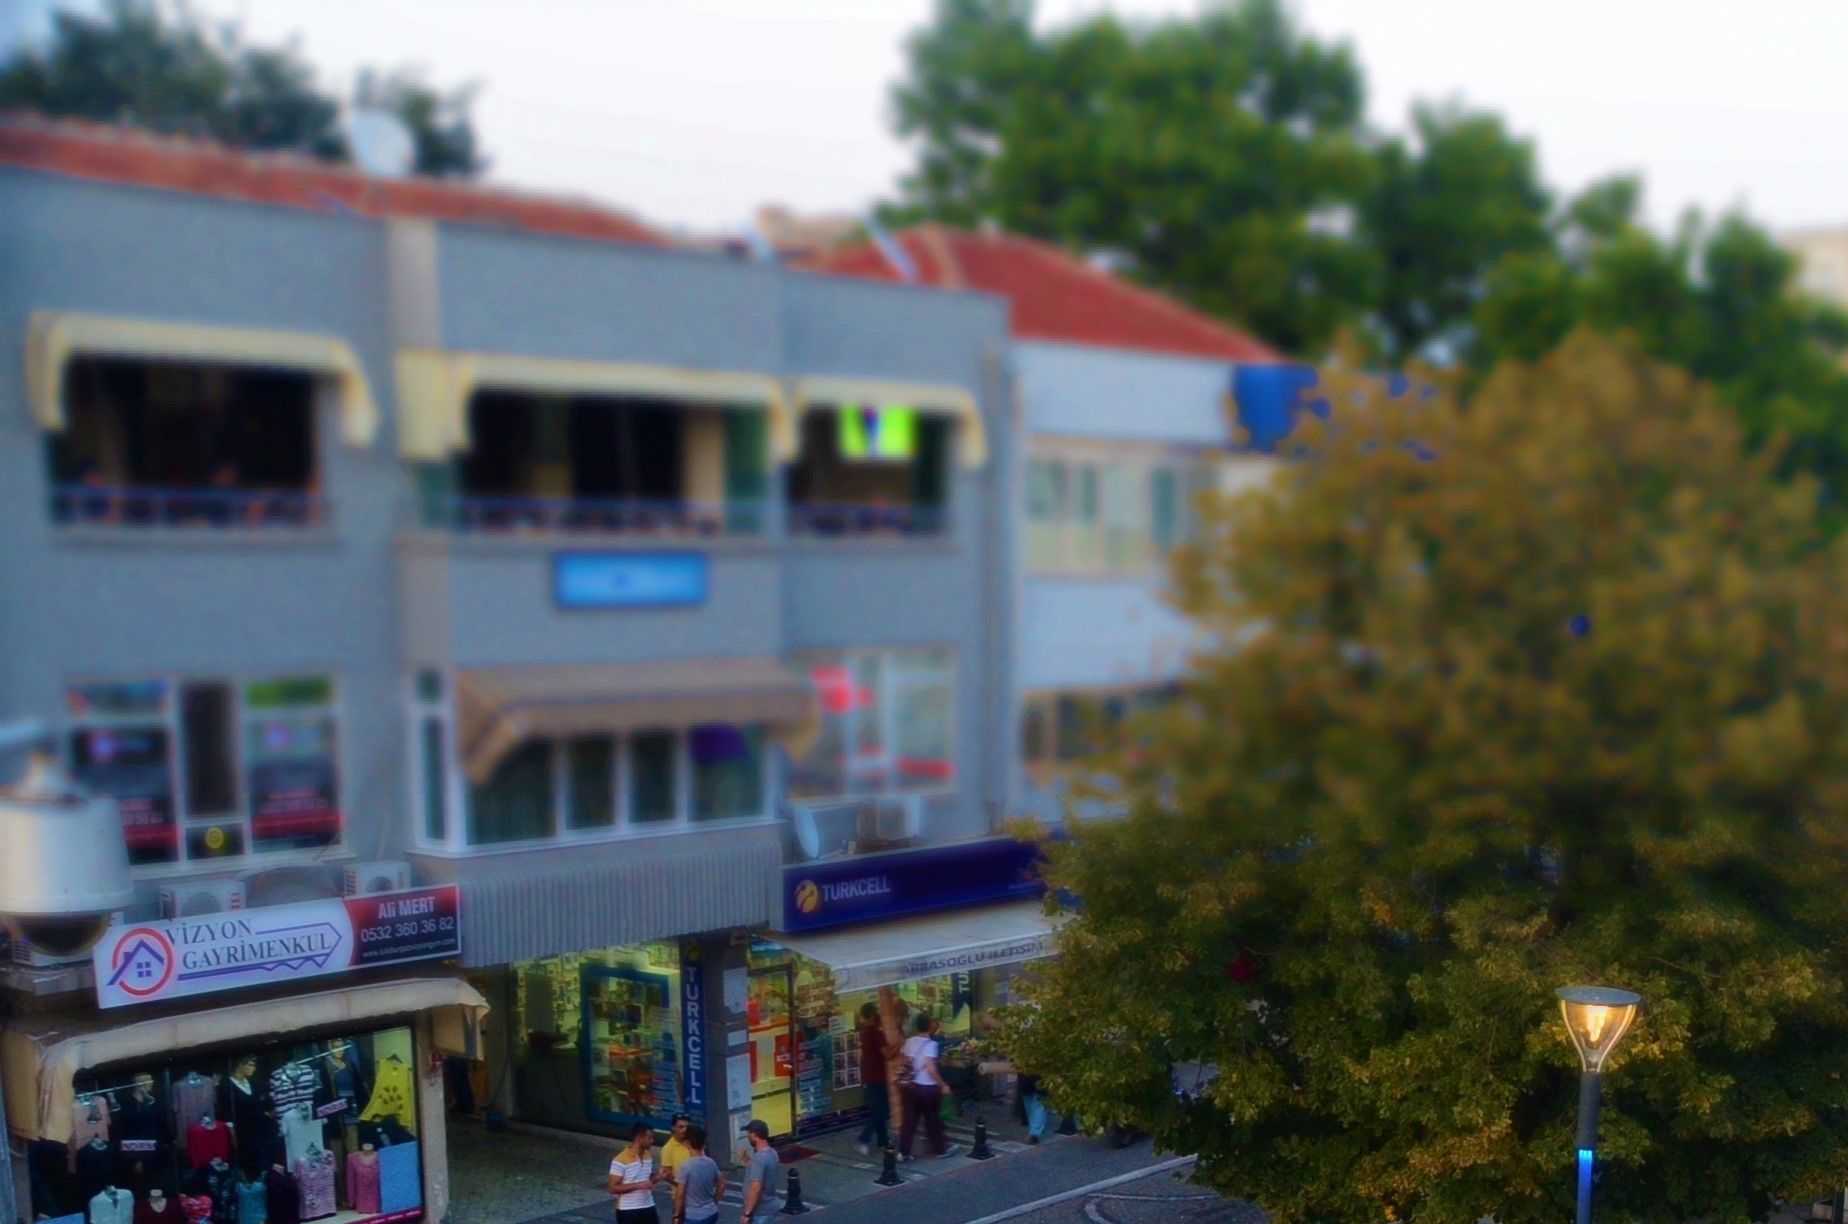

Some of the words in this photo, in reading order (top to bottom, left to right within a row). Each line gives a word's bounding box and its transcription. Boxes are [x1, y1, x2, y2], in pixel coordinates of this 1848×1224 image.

[822, 876, 891, 902] TURKCELL
[399, 896, 436, 916] MERT
[164, 918, 252, 946] VİZYON
[360, 925, 392, 942] 0532
[421, 918, 436, 933] 36
[439, 916, 454, 931] 82
[183, 932, 331, 970] GAYRİMENKUL
[686, 966, 702, 1104] TURKCELL
